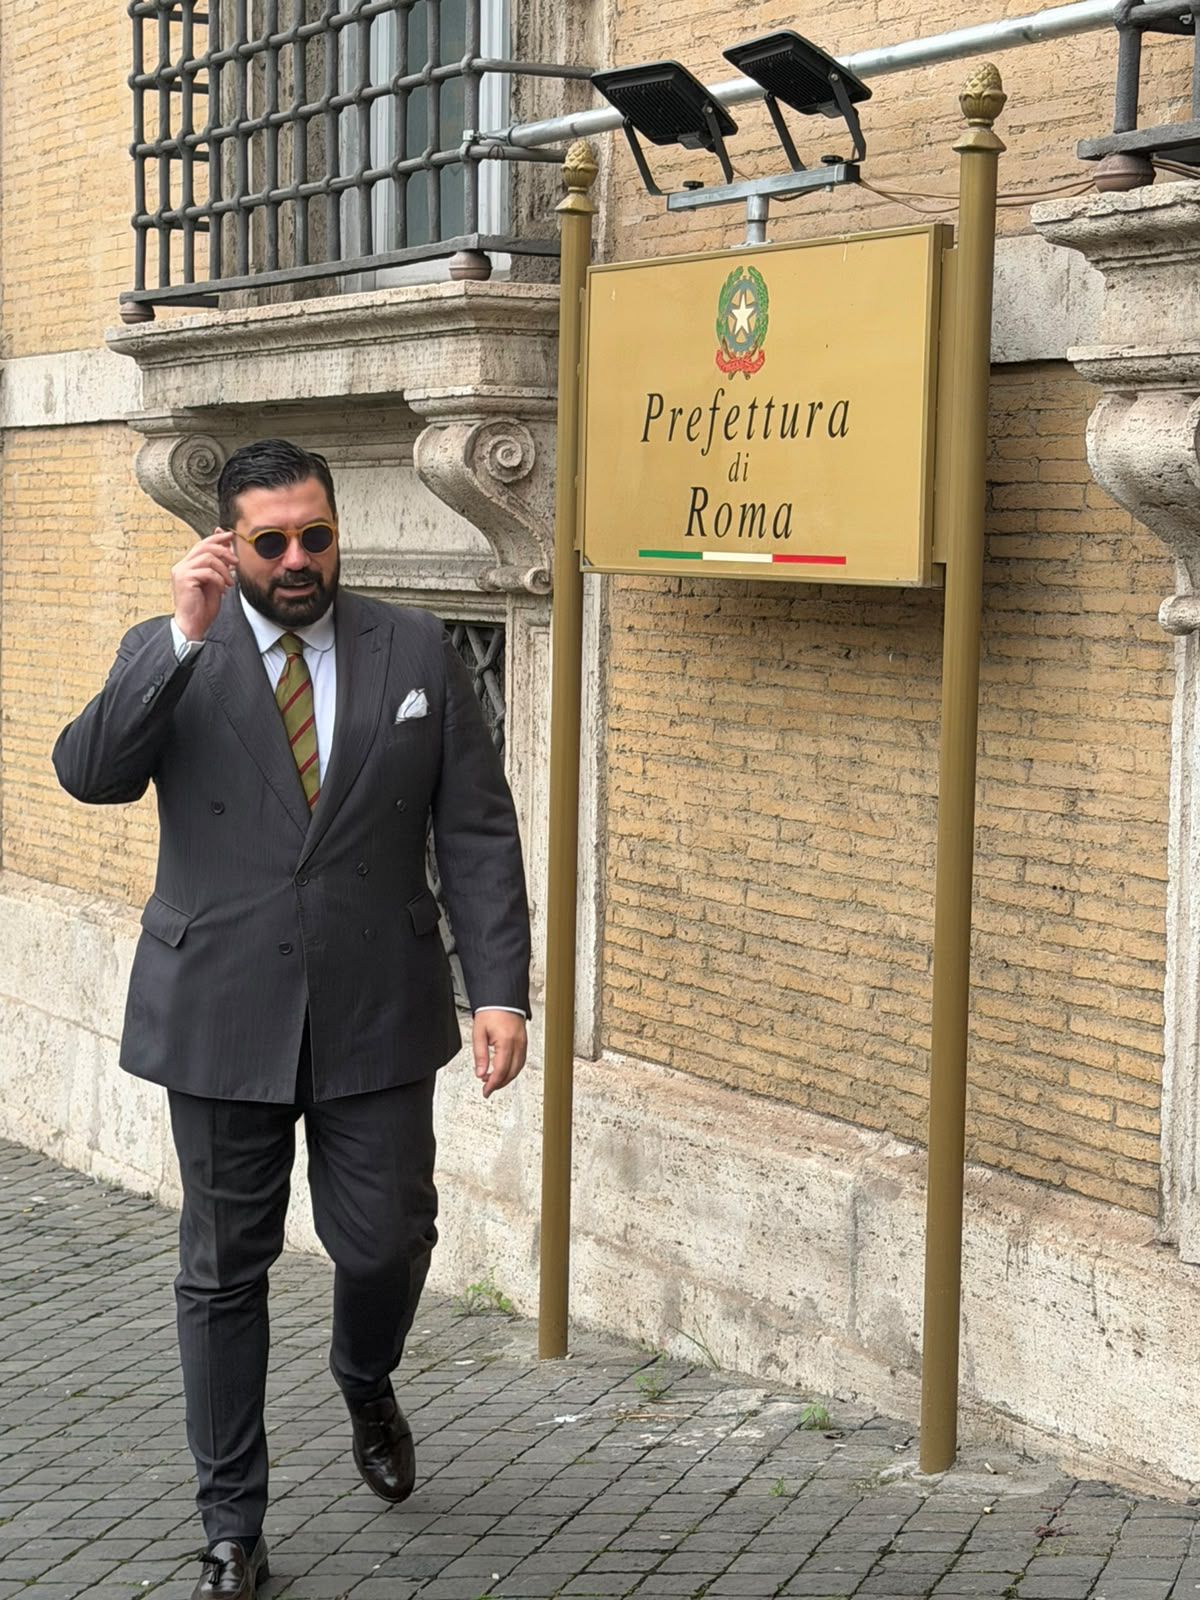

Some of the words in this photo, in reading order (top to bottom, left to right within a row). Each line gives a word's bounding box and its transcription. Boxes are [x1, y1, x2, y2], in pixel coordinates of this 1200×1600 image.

[640, 388, 850, 456] Prefettura
[728, 452, 750, 482] di
[684, 486, 793, 539] Roma
